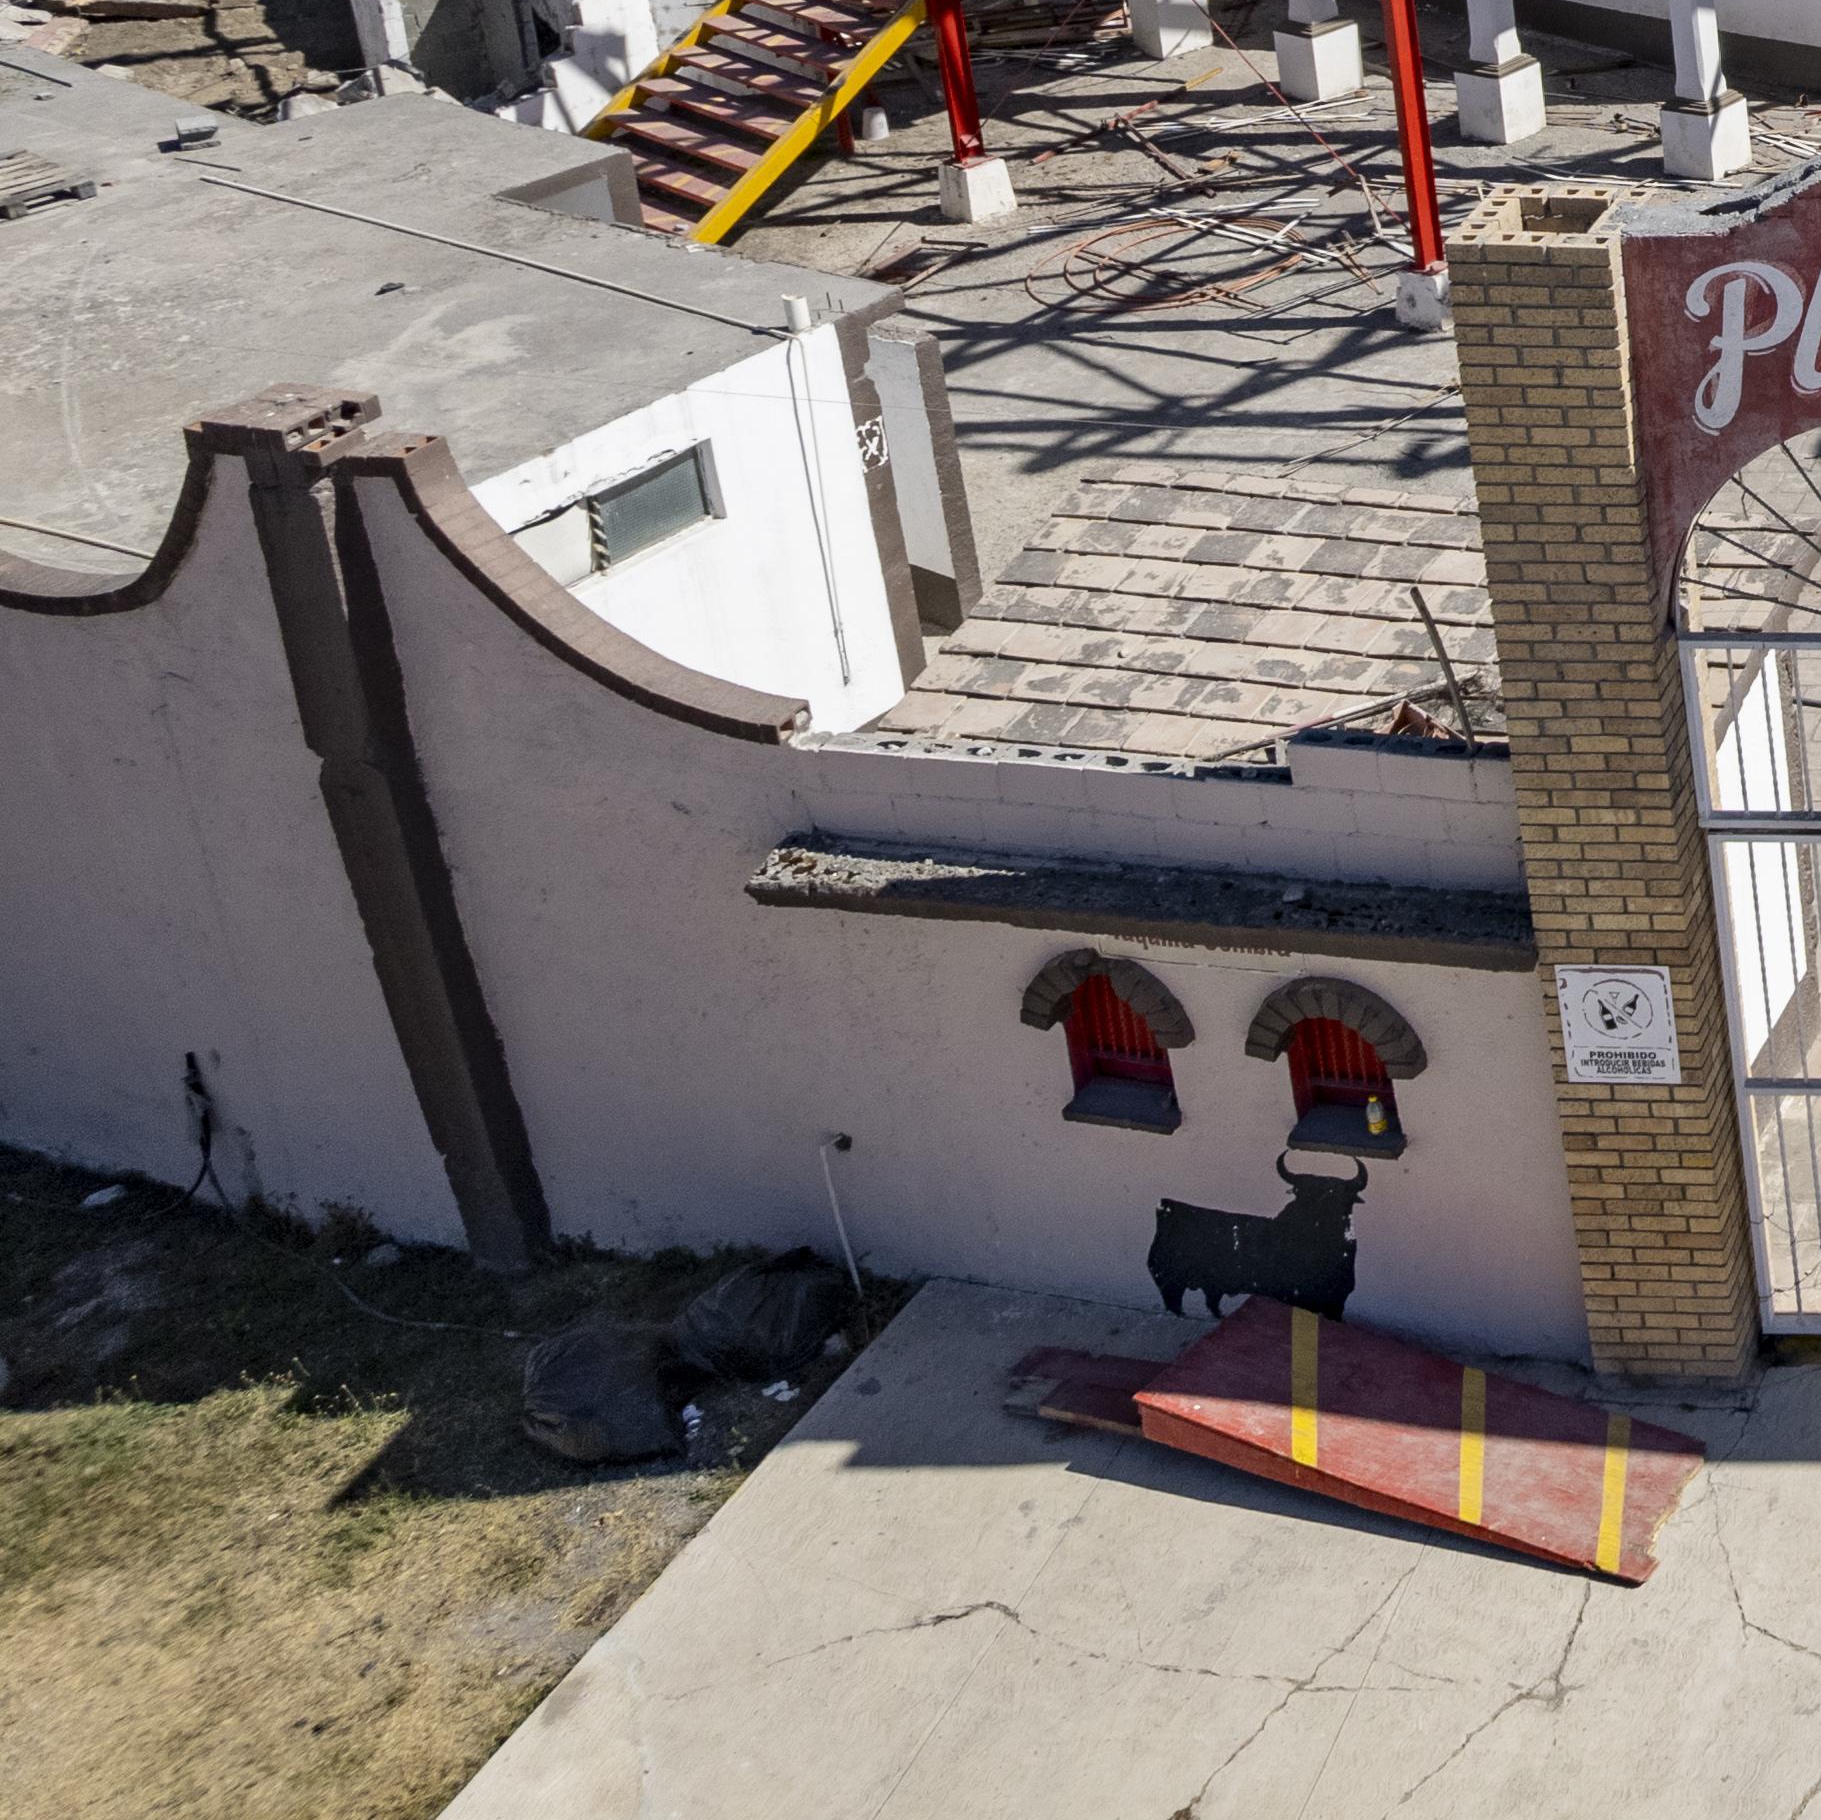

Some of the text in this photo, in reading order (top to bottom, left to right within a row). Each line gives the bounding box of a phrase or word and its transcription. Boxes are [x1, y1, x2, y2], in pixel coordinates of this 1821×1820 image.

[1589, 1050, 1657, 1059] PROHIBIDO
[1580, 1059, 1667, 1068] INTRODUCIR BEBIDAS
